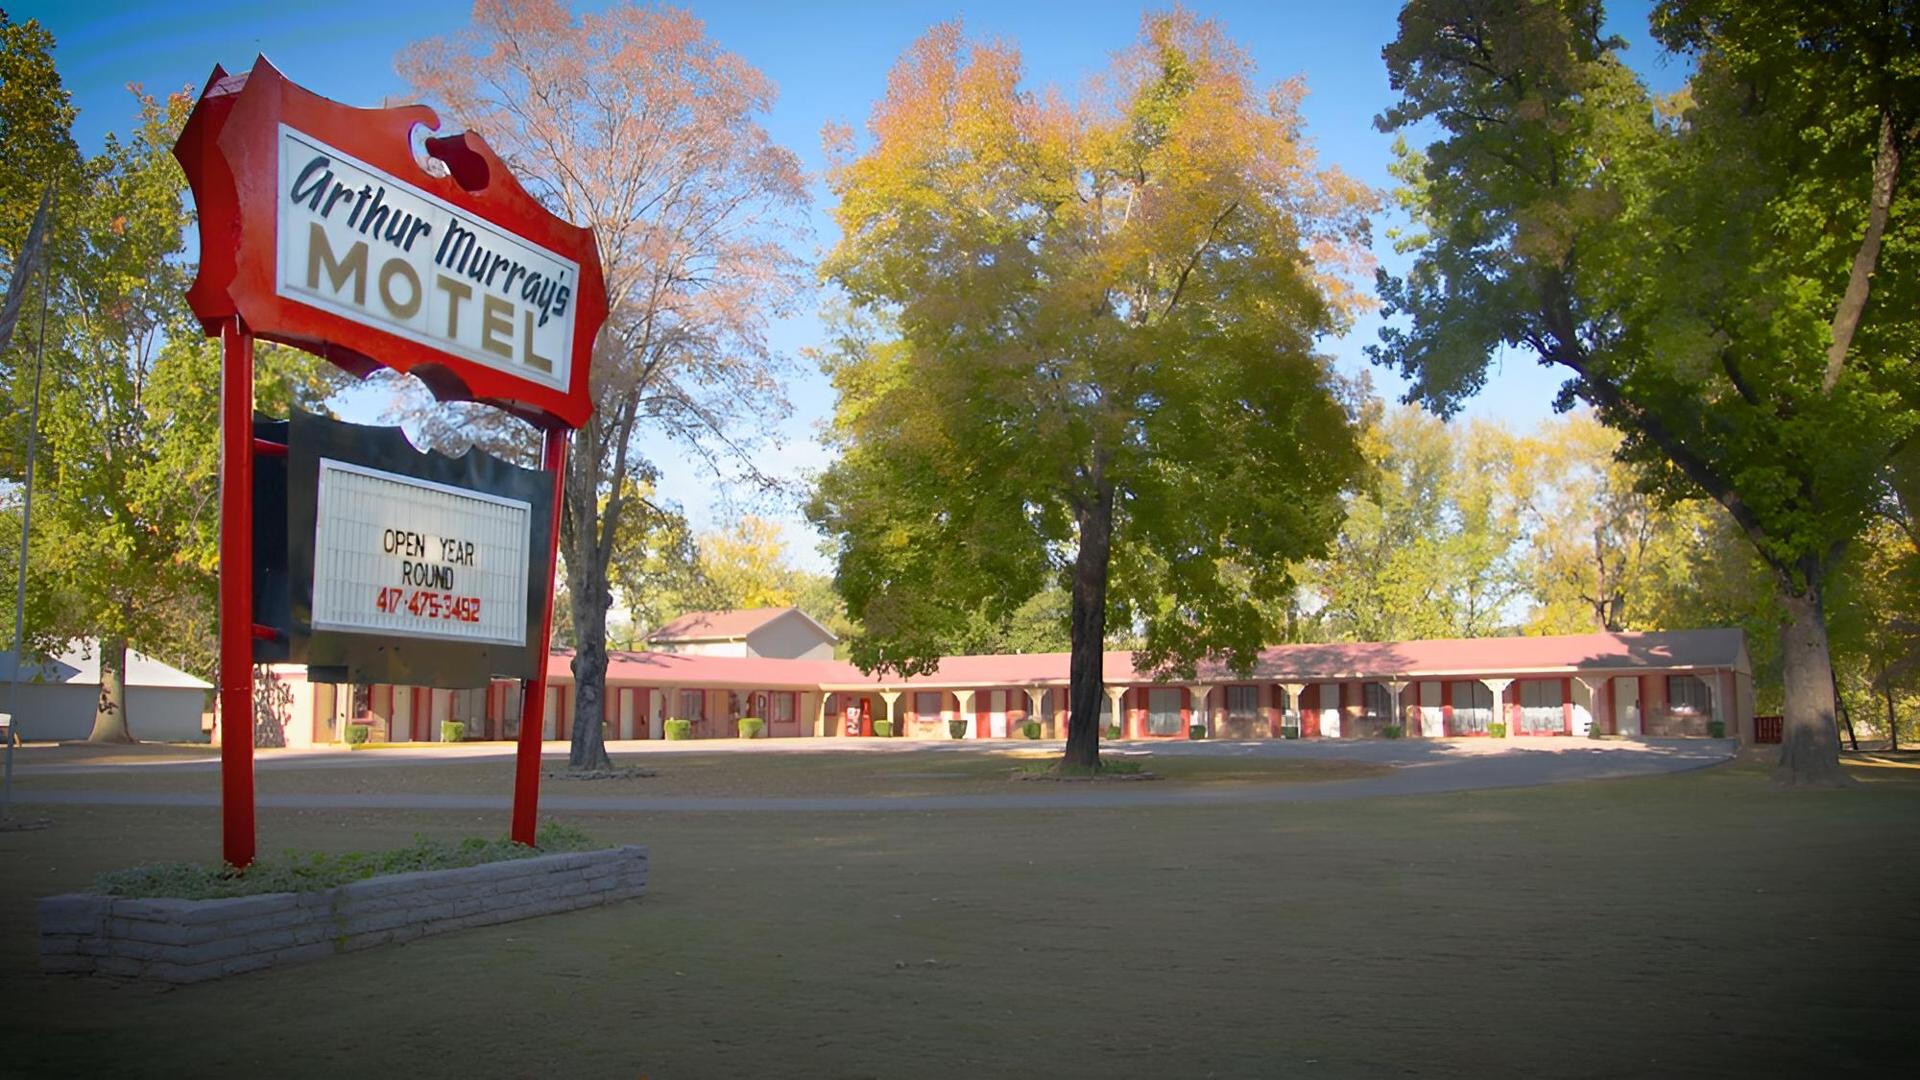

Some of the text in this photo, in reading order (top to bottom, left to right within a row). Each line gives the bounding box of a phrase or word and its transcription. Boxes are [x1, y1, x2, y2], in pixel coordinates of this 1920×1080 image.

[306, 222, 553, 374] MOTEL
[434, 218, 570, 328] Murray's
[384, 529, 475, 566] OPEN YEAR
[402, 561, 454, 590] ROUND
